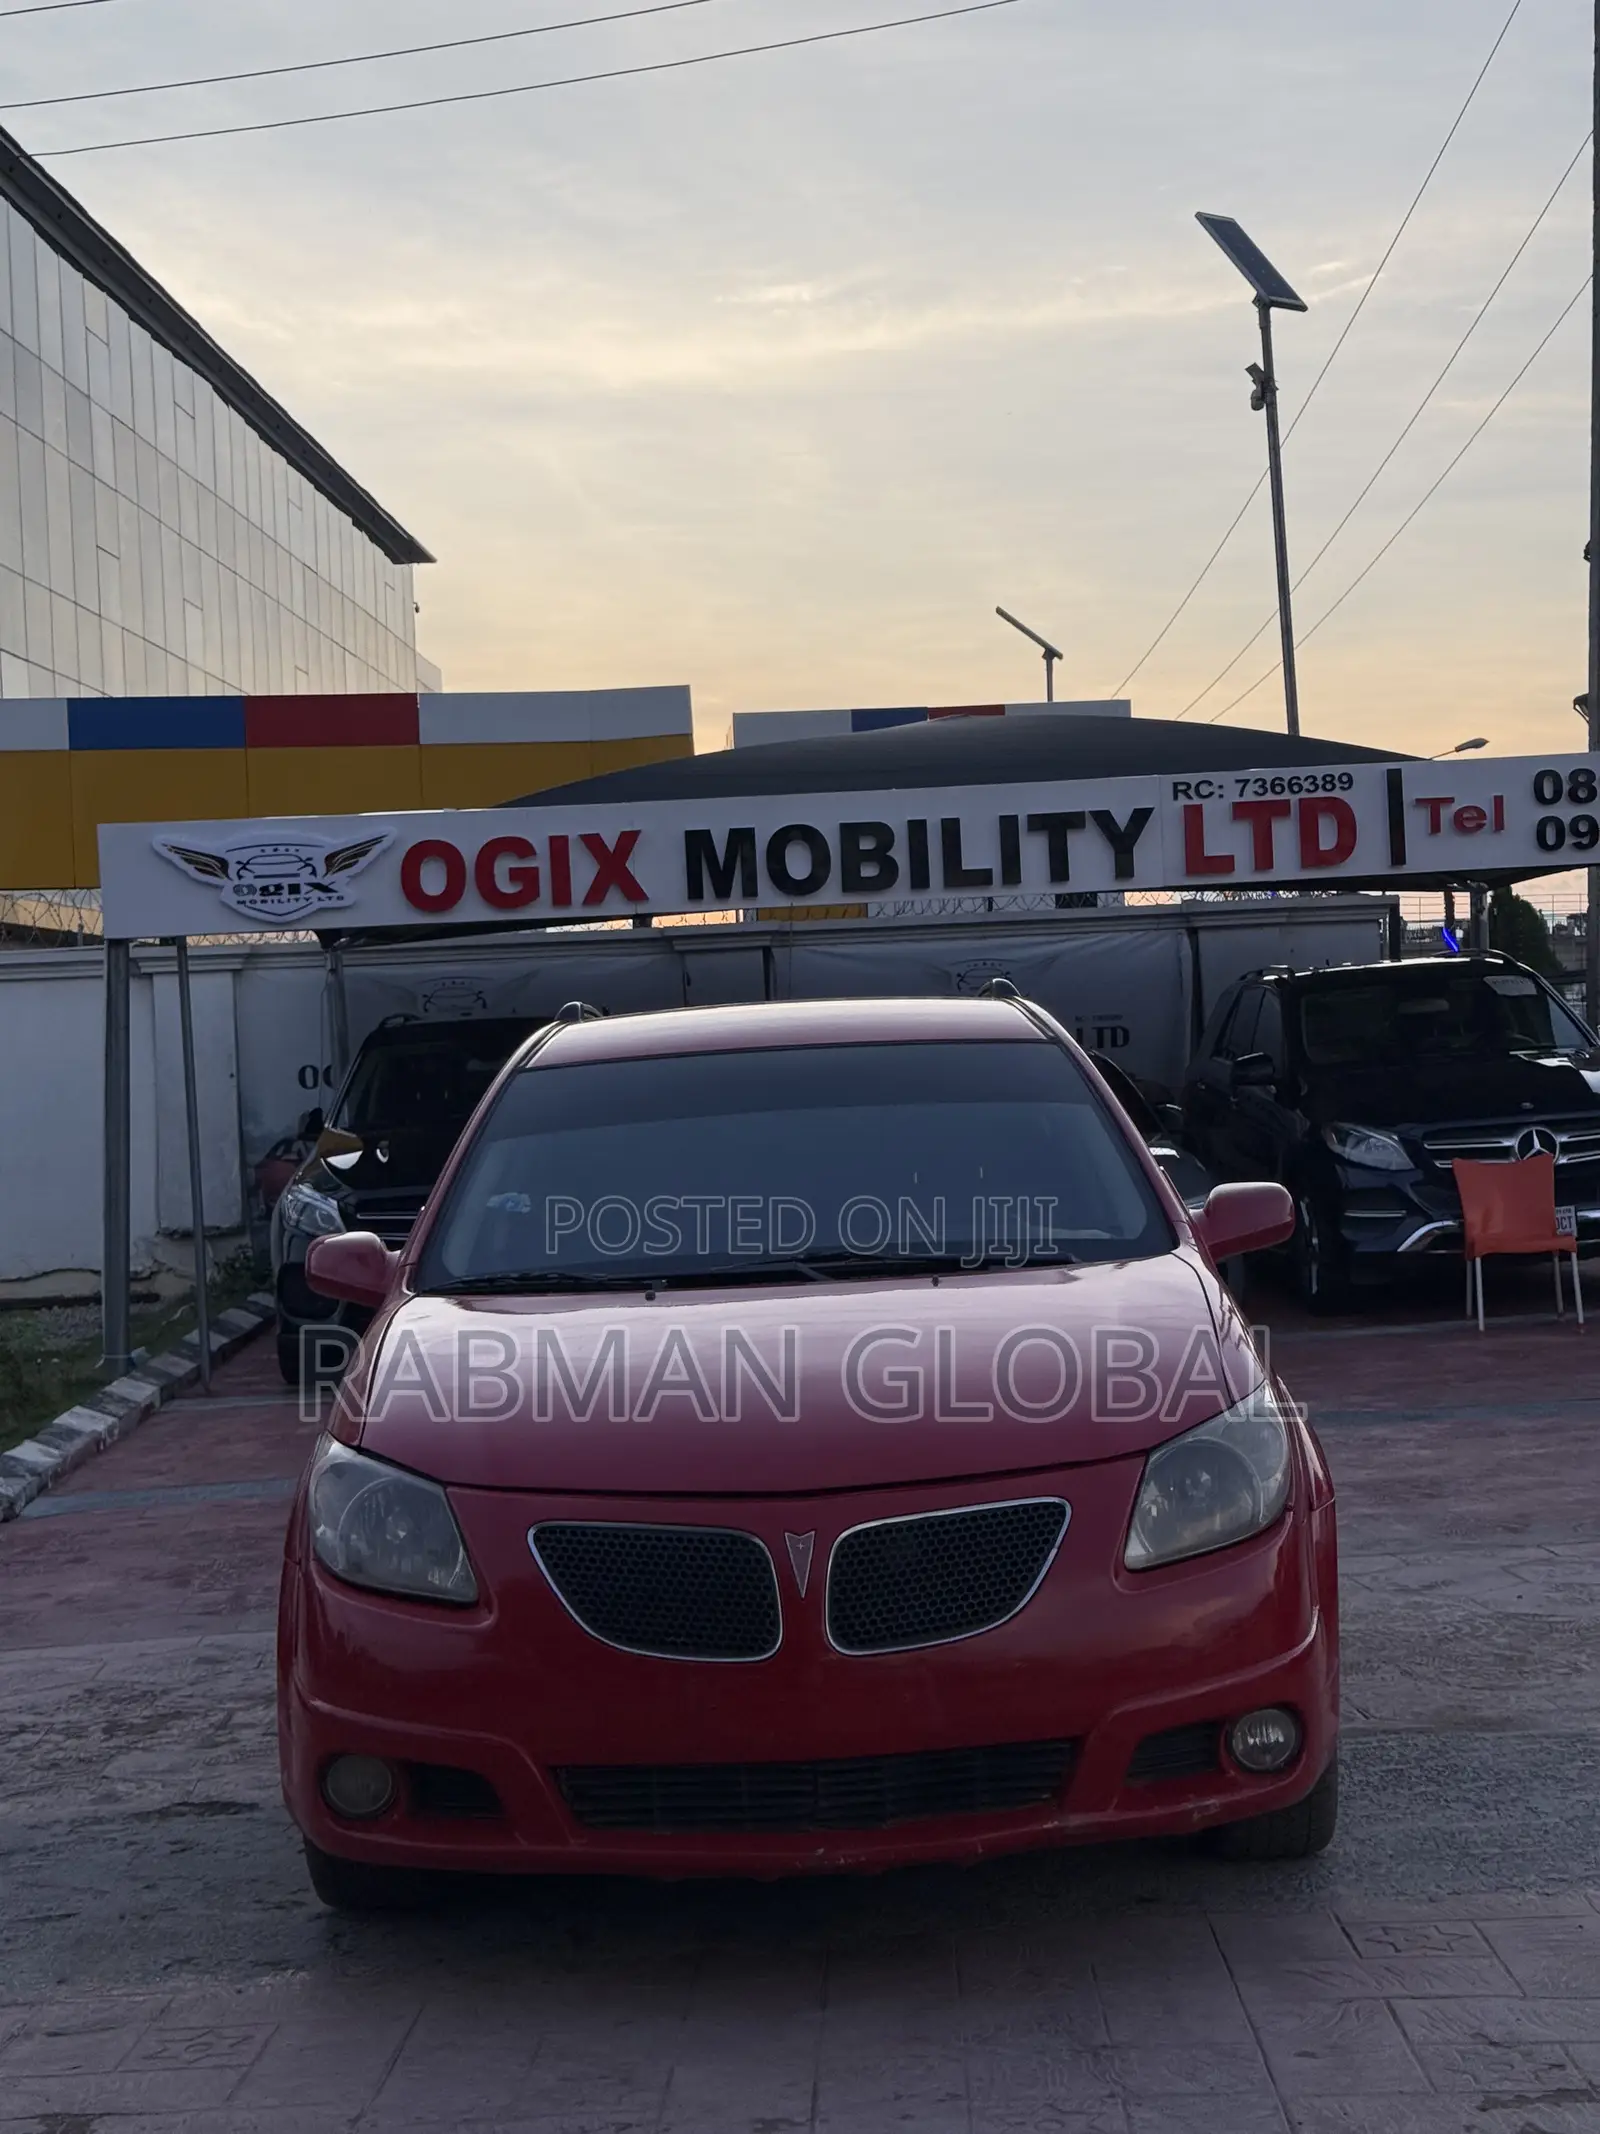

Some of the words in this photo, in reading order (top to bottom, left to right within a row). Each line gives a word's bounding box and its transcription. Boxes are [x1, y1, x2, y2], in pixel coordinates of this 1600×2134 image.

[1172, 779, 1224, 801] RC:
[1234, 771, 1354, 799] 7366389
[1533, 768, 1598, 805] 08
[1415, 794, 1505, 835] Tel
[1536, 814, 1600, 851] 09
[401, 829, 650, 913] OGIX
[684, 806, 1155, 901] MOBILITY
[1182, 796, 1358, 875] LTD
